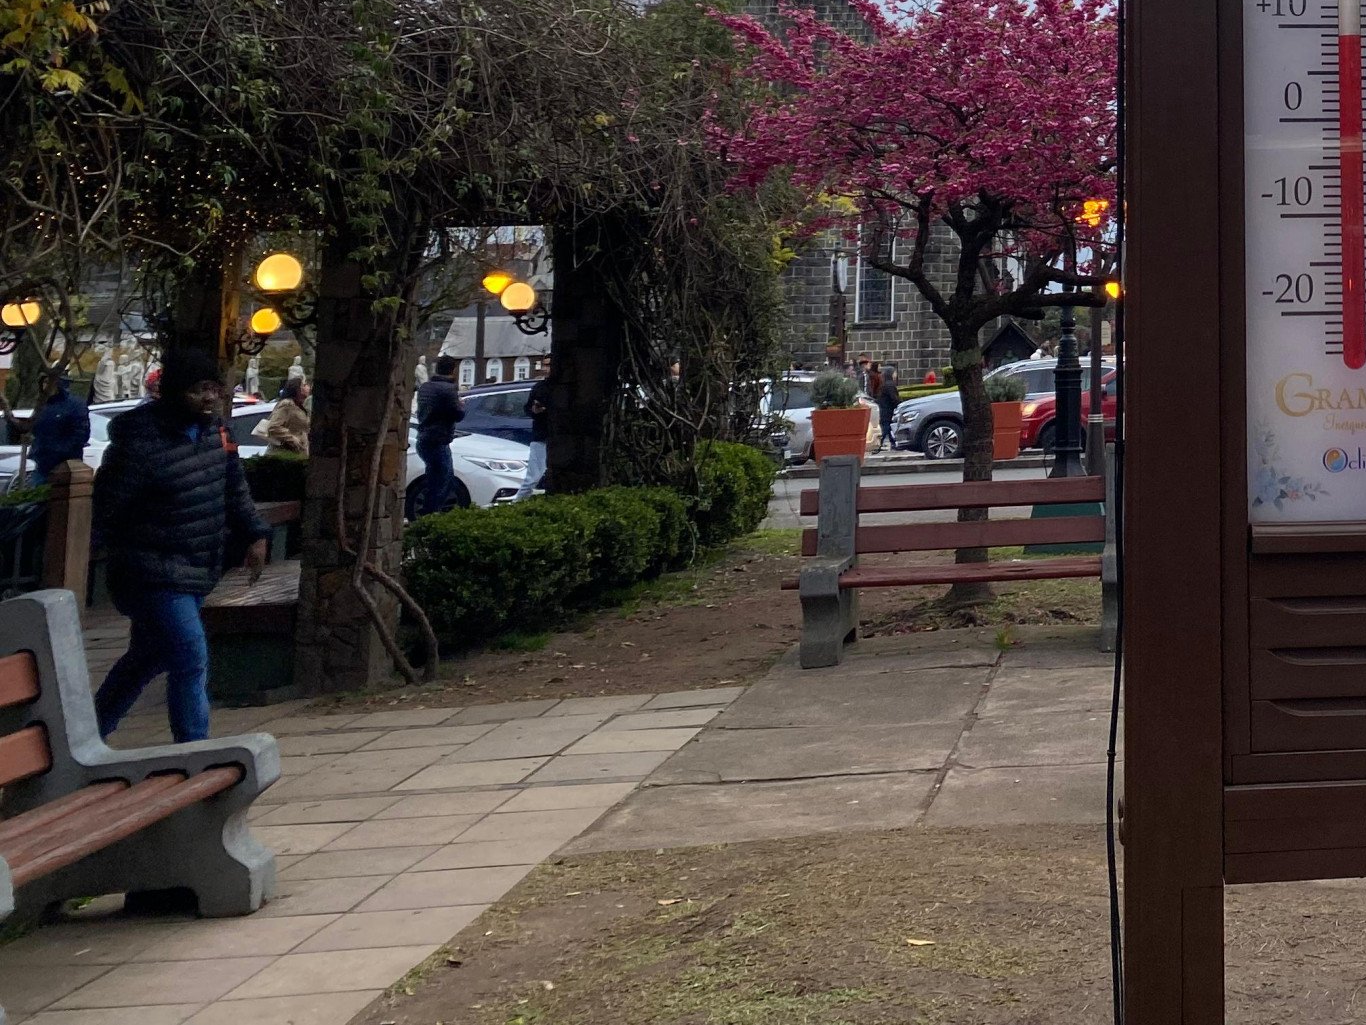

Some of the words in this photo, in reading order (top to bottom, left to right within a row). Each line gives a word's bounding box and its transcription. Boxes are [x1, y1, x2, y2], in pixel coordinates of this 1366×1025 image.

[1284, 82, 1302, 110] 0
[1261, 176, 1312, 205] -10
[1262, 273, 1314, 303] -20
